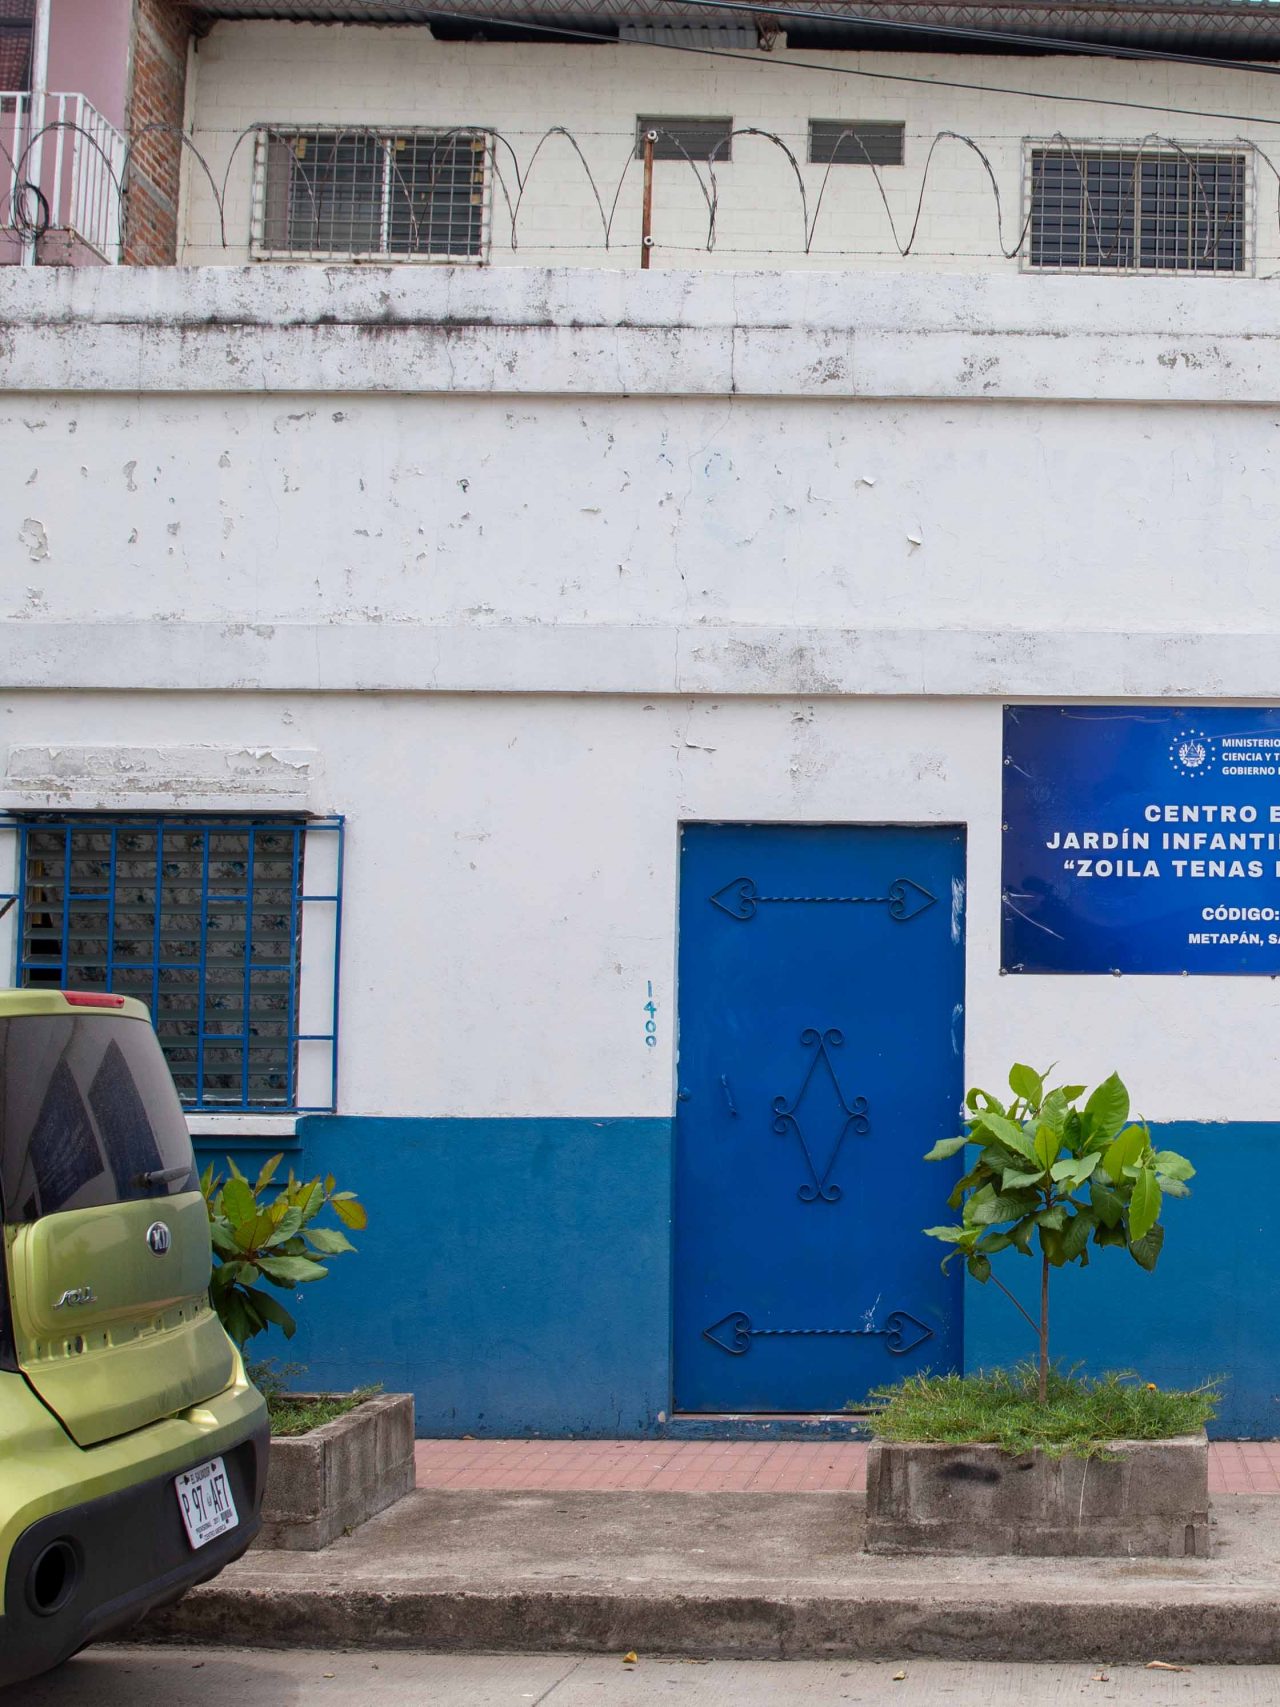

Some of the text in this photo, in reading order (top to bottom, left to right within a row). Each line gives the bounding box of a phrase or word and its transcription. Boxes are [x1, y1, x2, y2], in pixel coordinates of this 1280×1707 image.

[1222, 738, 1280, 748] MINISTERIO
[1222, 752, 1263, 761] CIENCIA
[1264, 752, 1272, 761] Y
[1222, 766, 1276, 775] GOBIERNO
[1144, 804, 1257, 823] CENTRO
[1046, 828, 1149, 850] JARDÍN
[1063, 859, 1161, 877] “ZOILA
[1171, 860, 1263, 878] TENAS
[1201, 904, 1280, 921] CÓDIGO:
[1188, 931, 1264, 946] METAPÁN,
